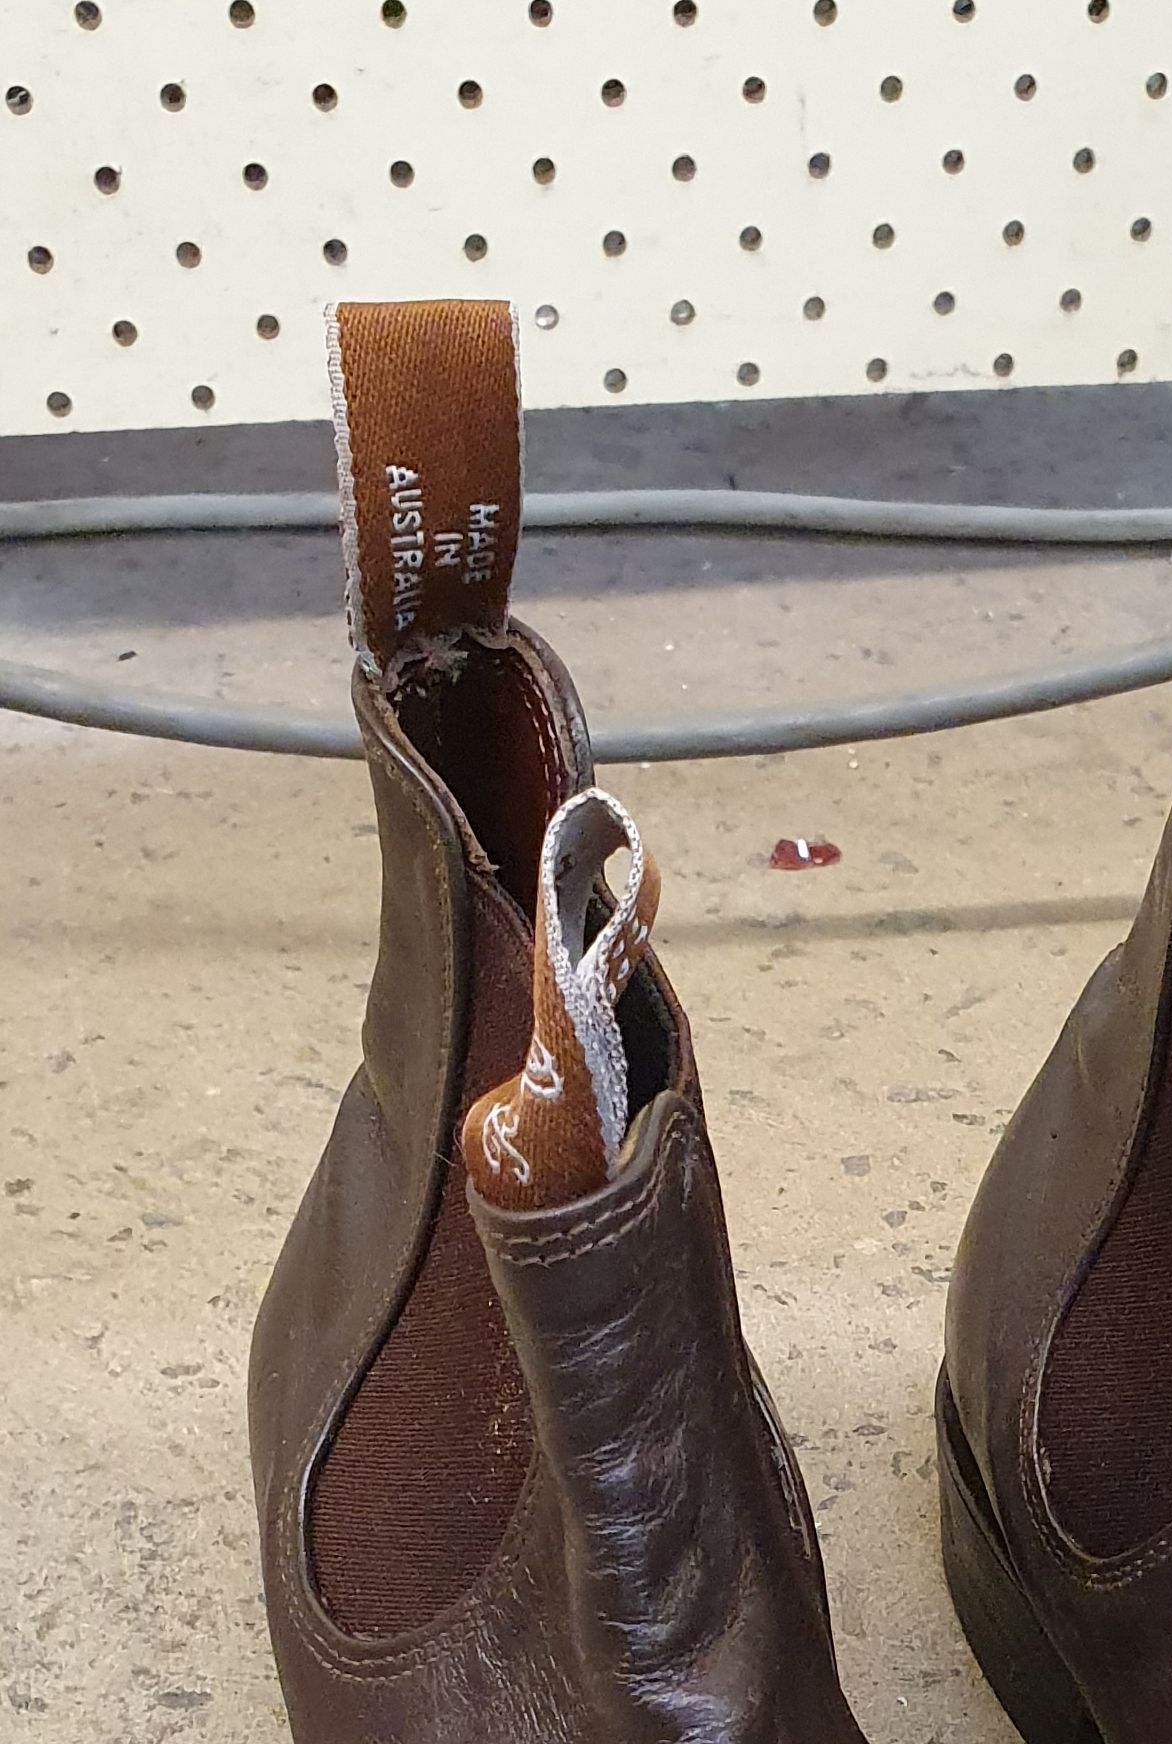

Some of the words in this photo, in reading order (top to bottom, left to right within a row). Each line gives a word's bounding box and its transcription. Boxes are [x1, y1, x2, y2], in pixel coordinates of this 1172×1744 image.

[384, 464, 425, 631] AUSTRALIA
[433, 532, 464, 567] IN
[463, 503, 501, 585] MADE
